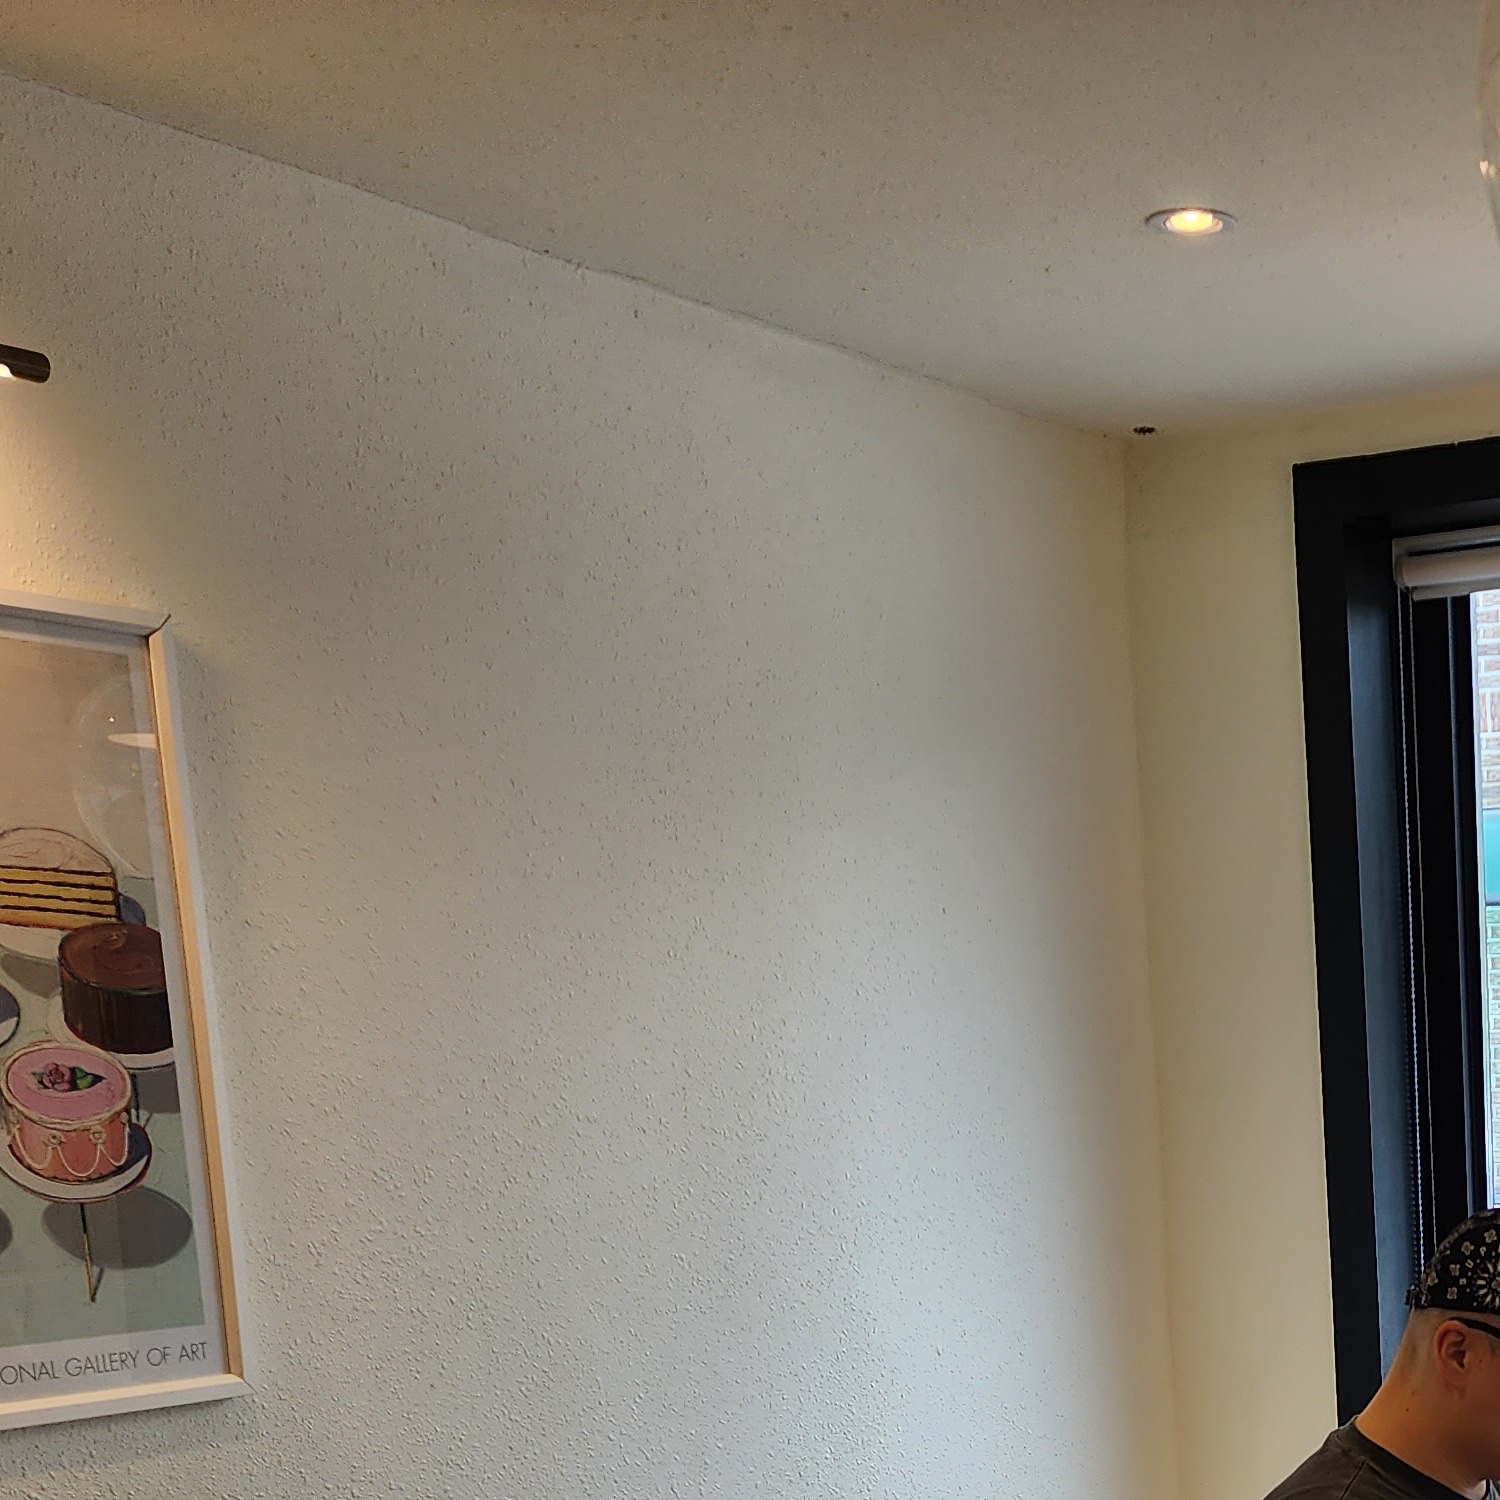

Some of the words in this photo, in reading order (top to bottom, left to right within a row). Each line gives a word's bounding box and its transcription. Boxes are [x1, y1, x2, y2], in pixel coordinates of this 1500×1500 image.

[0, 1360, 60, 1385] ONAL
[64, 1350, 140, 1377] GALLERY
[147, 1346, 171, 1367] OF
[179, 1341, 207, 1363] ART
